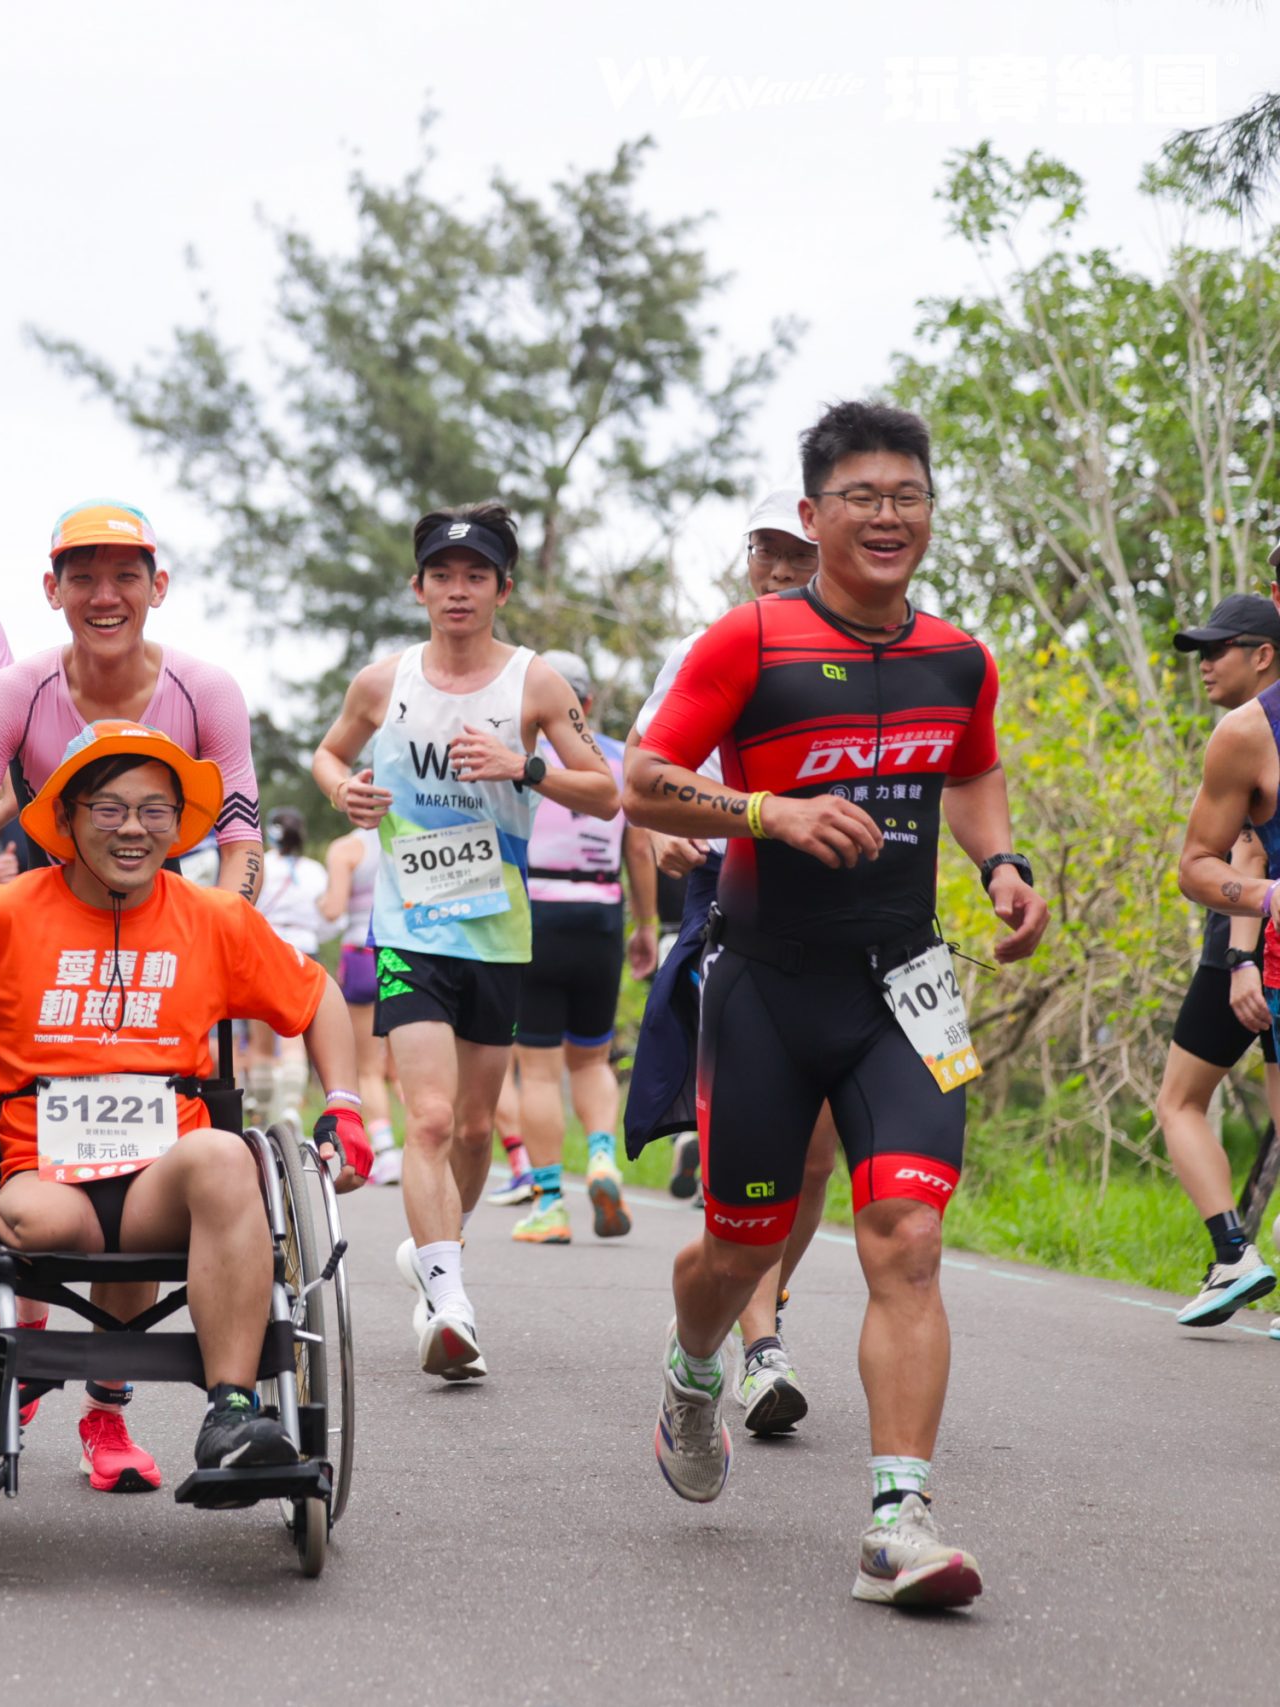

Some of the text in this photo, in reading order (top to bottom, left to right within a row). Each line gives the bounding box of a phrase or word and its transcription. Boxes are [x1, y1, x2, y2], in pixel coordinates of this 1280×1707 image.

[796, 739, 954, 779] DVTT
[415, 793, 483, 809] MARATHON
[853, 784, 923, 801] 原力復健
[401, 840, 493, 874] 30043
[55, 950, 178, 988] 愛運動
[38, 989, 162, 1028] 動無礙
[33, 1034, 180, 1046] TOGETHER MOVE
[46, 1095, 164, 1124] 51221
[77, 1142, 140, 1160] 陳元皓
[894, 1168, 953, 1192] DVTT
[713, 1214, 777, 1228] DVTT
